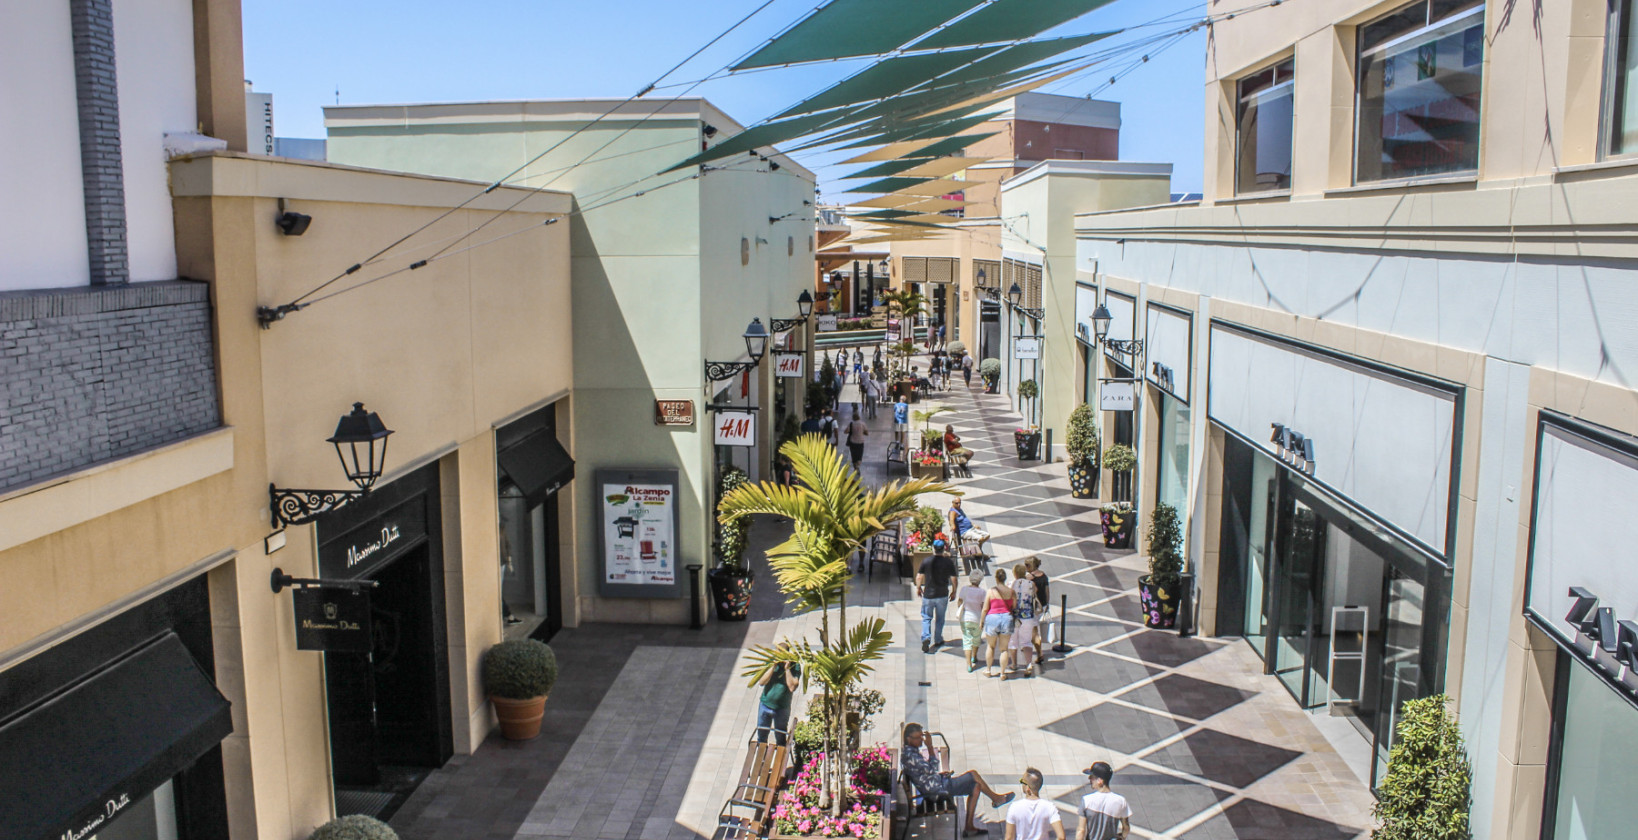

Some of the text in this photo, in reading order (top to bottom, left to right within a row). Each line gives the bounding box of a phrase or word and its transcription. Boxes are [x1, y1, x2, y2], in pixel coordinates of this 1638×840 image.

[264, 102, 273, 156] HITECS
[720, 418, 750, 438] H&M
[624, 486, 671, 497] Alcampo
[347, 525, 400, 569] Massimo Dutti
[105, 793, 131, 819] Dutti
